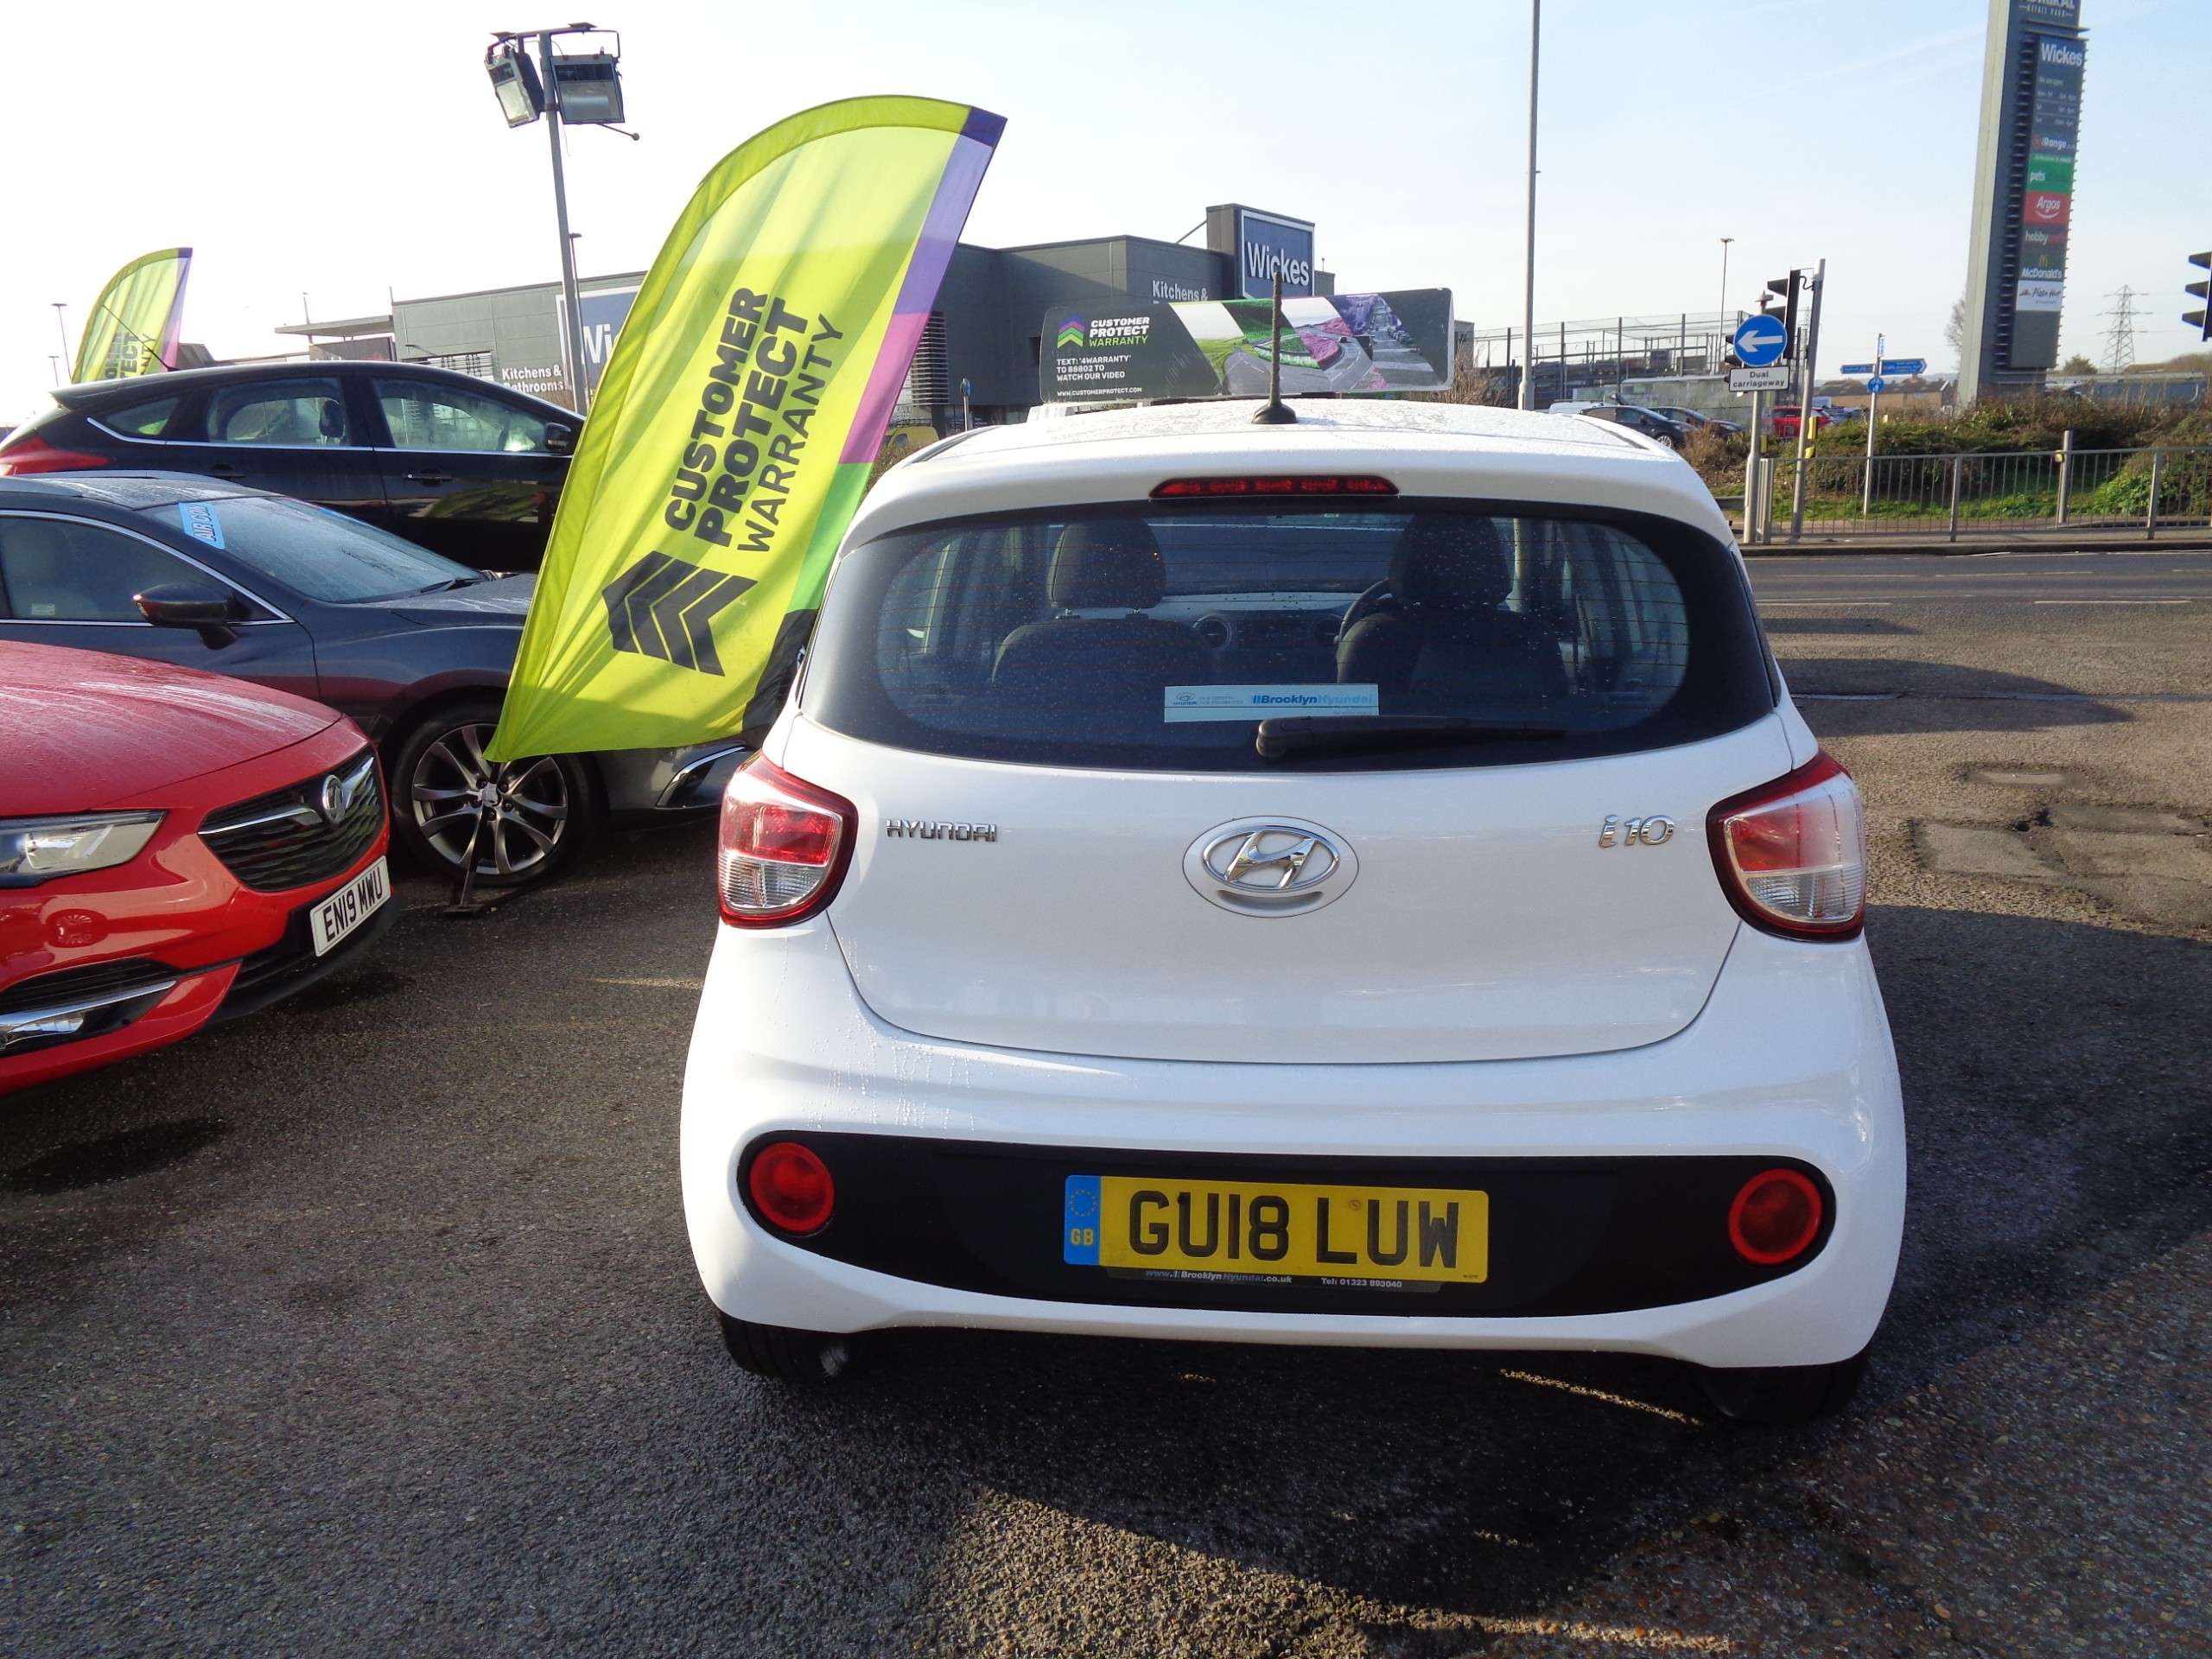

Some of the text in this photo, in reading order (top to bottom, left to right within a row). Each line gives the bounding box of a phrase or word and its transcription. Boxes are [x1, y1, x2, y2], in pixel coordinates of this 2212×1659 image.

[2041, 42, 2082, 67] Wickes
[2037, 195, 2061, 213] Argos
[1248, 241, 1310, 286] Wickes
[2022, 267, 2063, 279] McDonald's
[1152, 280, 1209, 302] Kitchens &
[1090, 316, 1150, 327] CUSTOMER
[1090, 325, 1149, 338] PROTECT
[1089, 335, 1148, 347] WARRANTY
[501, 365, 563, 380] Kitchens &
[1102, 371, 1125, 379] VIDEO
[1057, 387, 1142, 397] WWW.CUSTOMERPROTECT.COM
[664, 288, 768, 531] CUSTOMER
[694, 297, 808, 548] PROTECT
[737, 313, 843, 552] WARRANTY
[887, 819, 996, 842] HYUNDAI
[1599, 815, 1674, 848] i10
[322, 867, 383, 942] EN19 MWU
[1071, 1228, 1094, 1245] GB
[1128, 1189, 1460, 1268] GU18 LUW
[1339, 1278, 1367, 1287] 01323
